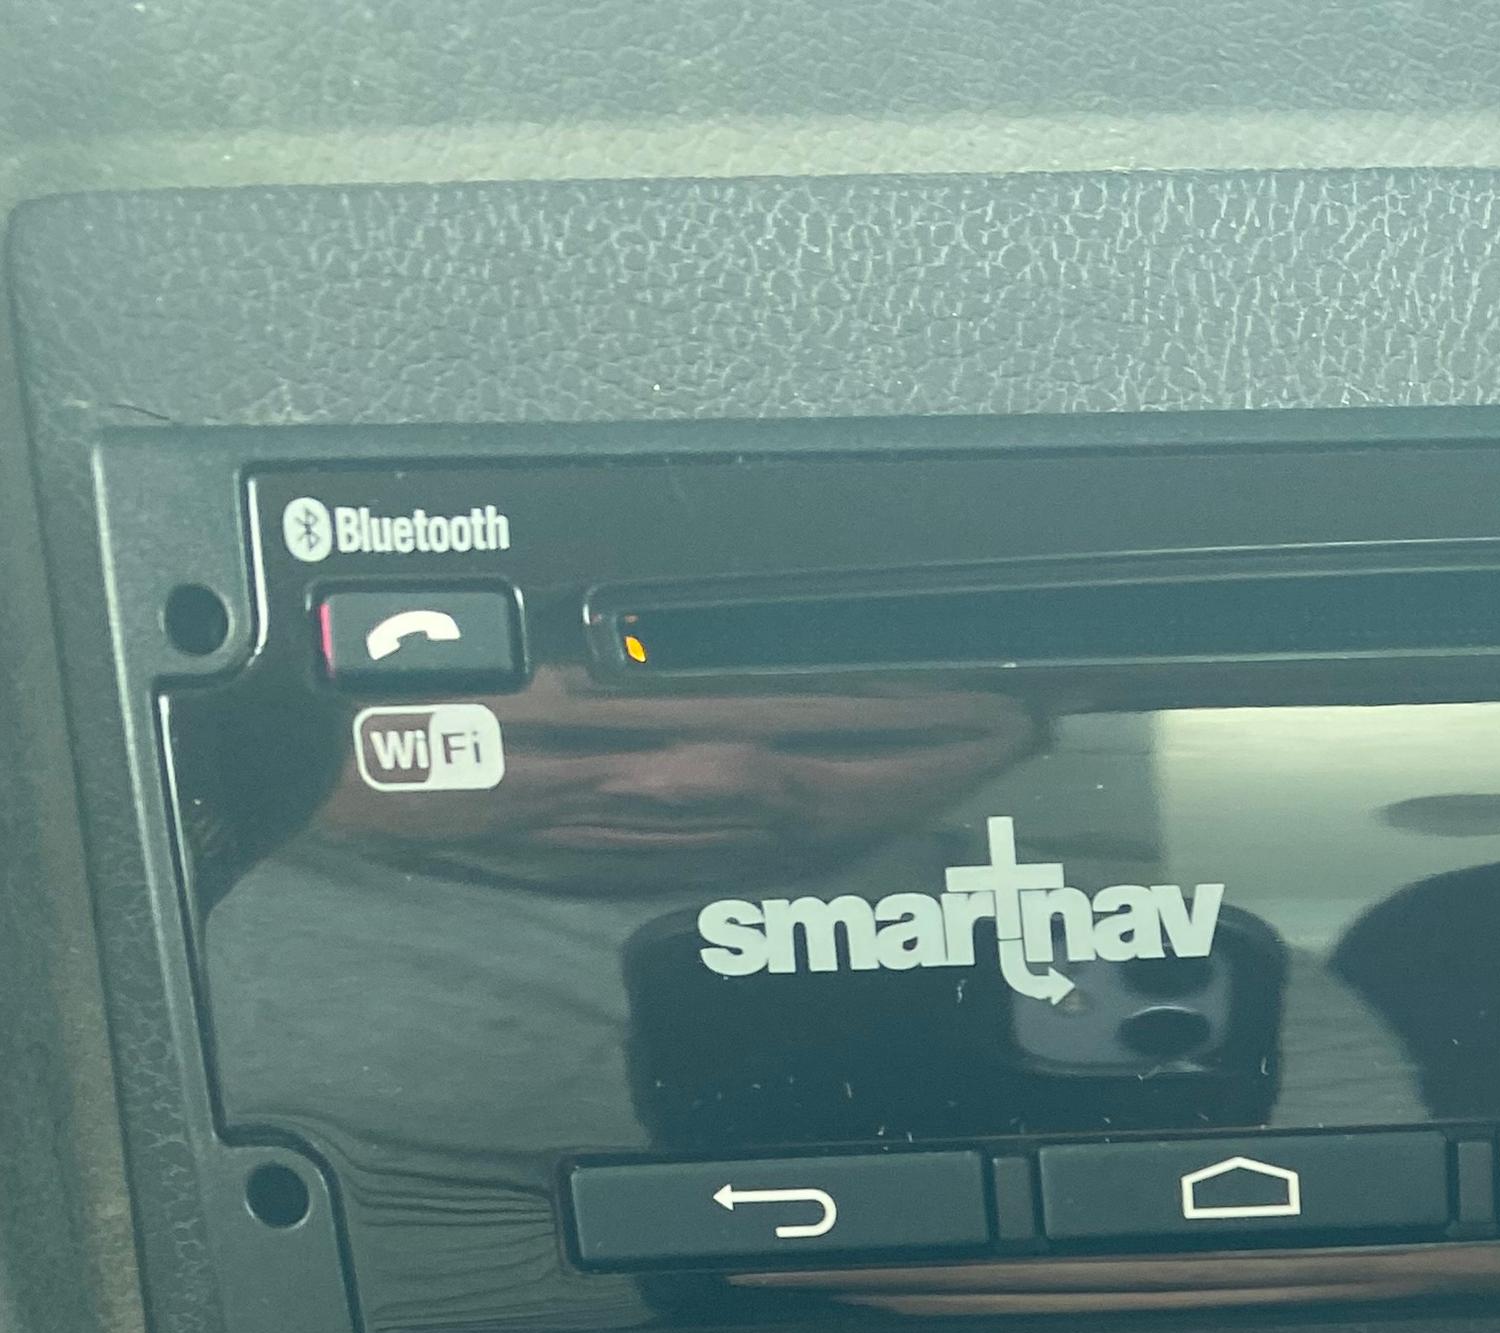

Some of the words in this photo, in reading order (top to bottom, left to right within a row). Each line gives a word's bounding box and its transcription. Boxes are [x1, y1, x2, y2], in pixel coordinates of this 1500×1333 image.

[336, 505, 510, 556] Bluetooth
[370, 726, 484, 774] WiFi
[697, 815, 1225, 1006] smartnav
